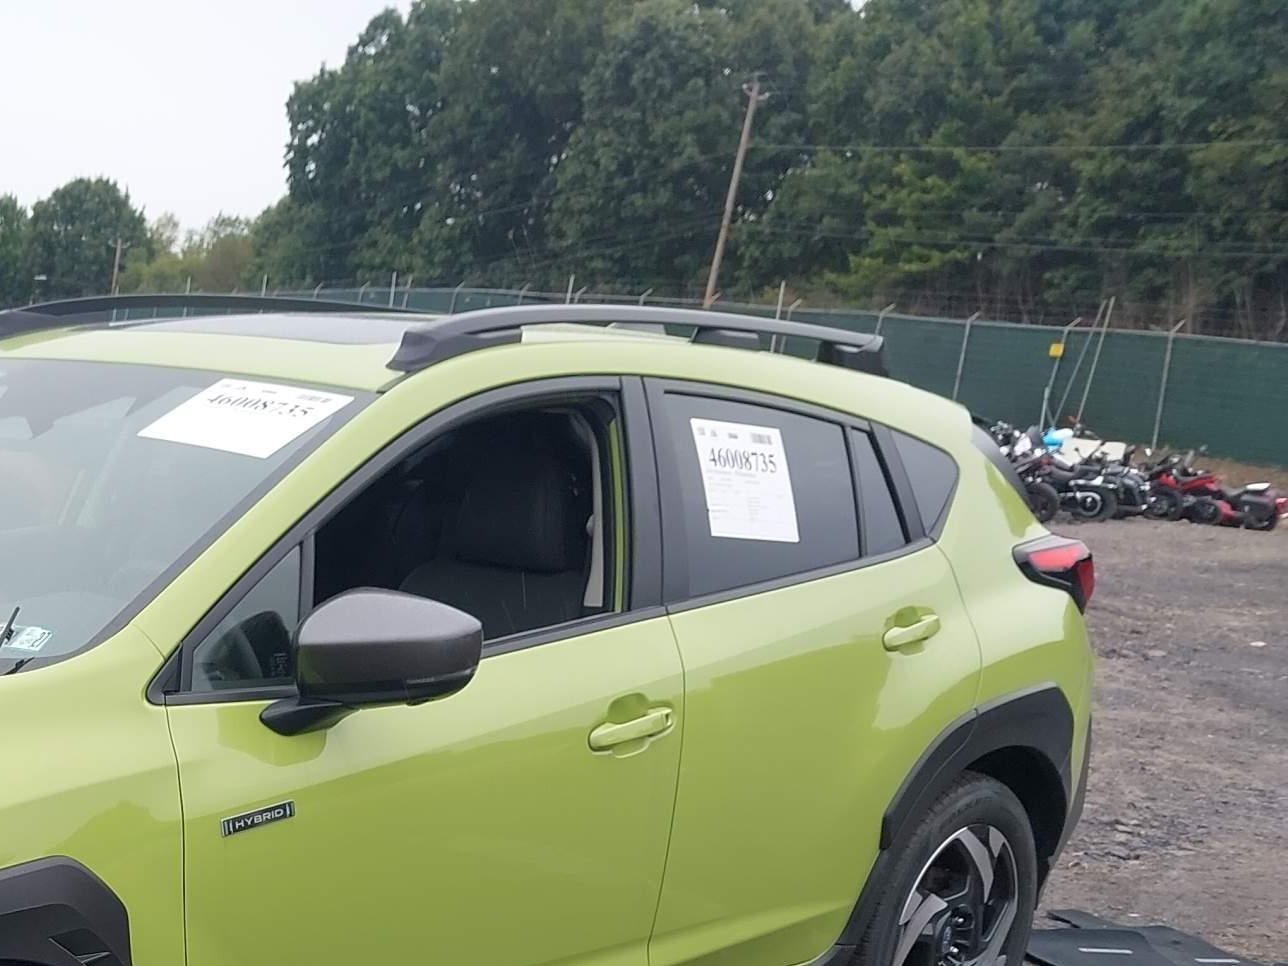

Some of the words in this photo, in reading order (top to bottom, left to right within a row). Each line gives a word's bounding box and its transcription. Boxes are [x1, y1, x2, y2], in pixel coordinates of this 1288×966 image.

[206, 394, 316, 418] 46008735
[709, 447, 778, 474] 46008735
[235, 808, 285, 830] HYBRID
